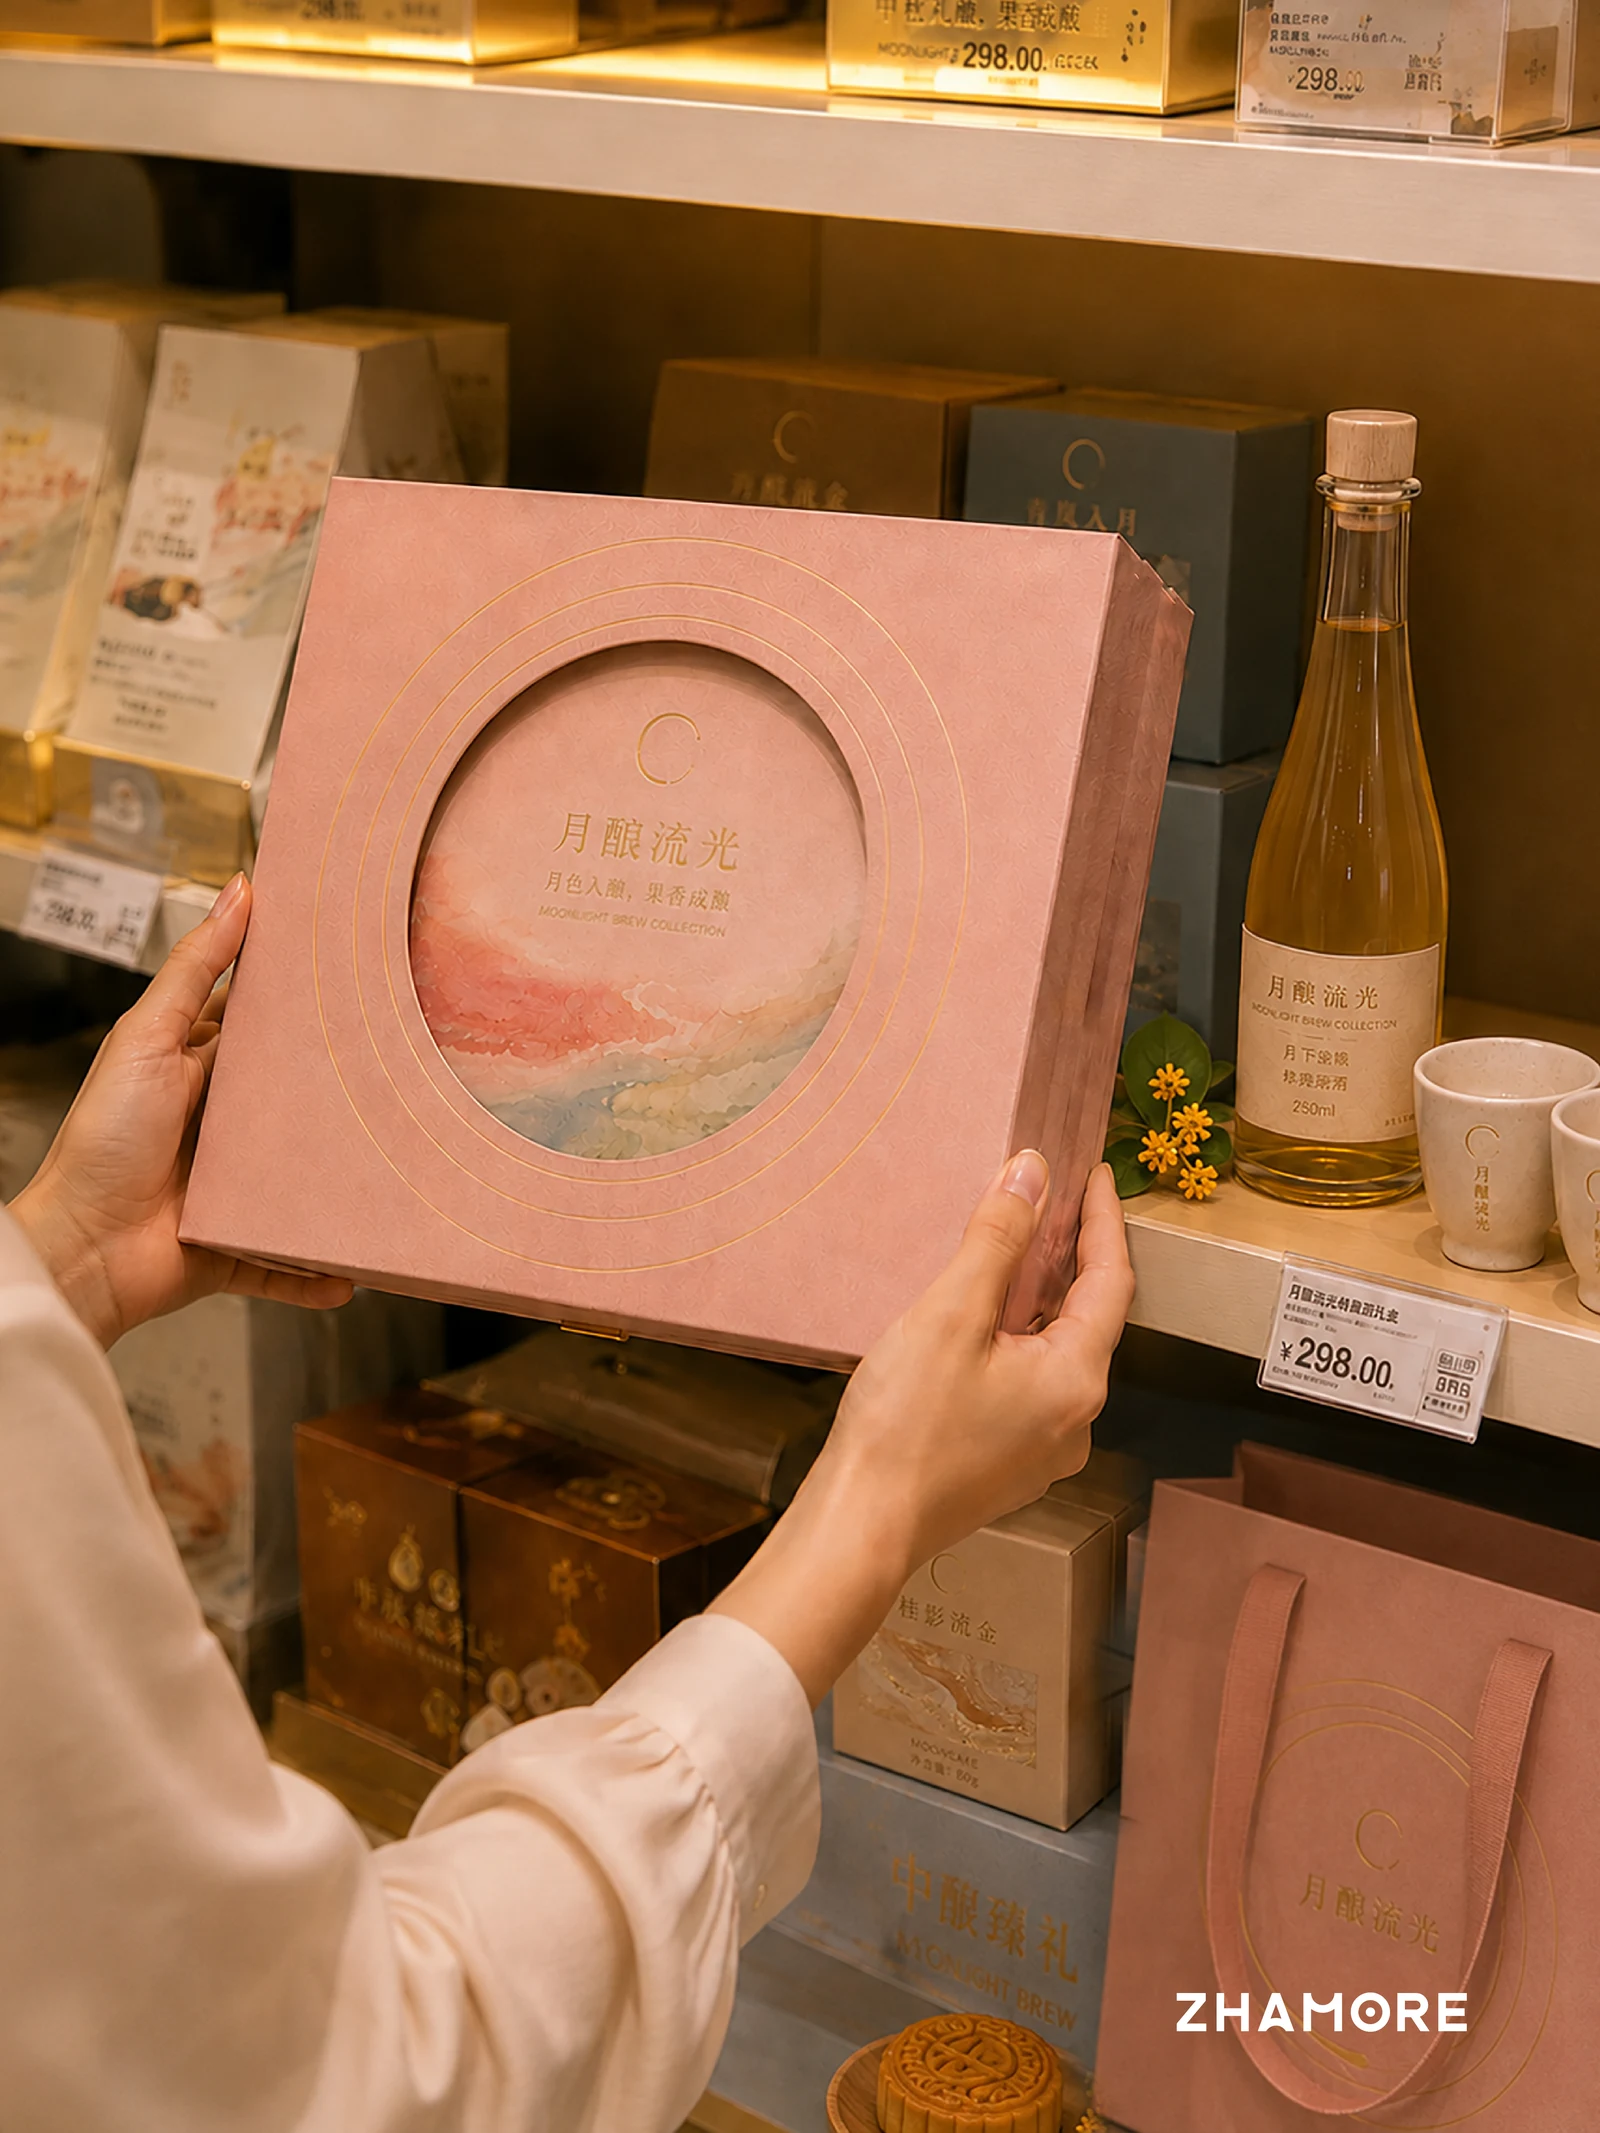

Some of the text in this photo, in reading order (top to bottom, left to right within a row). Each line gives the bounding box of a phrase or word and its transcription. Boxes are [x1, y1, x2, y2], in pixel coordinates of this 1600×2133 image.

[552, 811, 741, 872] 月酿流光
[612, 913, 648, 928] BREW
[650, 918, 727, 938] COLLECTION
[898, 1594, 999, 1646] 桂影流金
[1016, 1984, 1079, 2034] BREW
